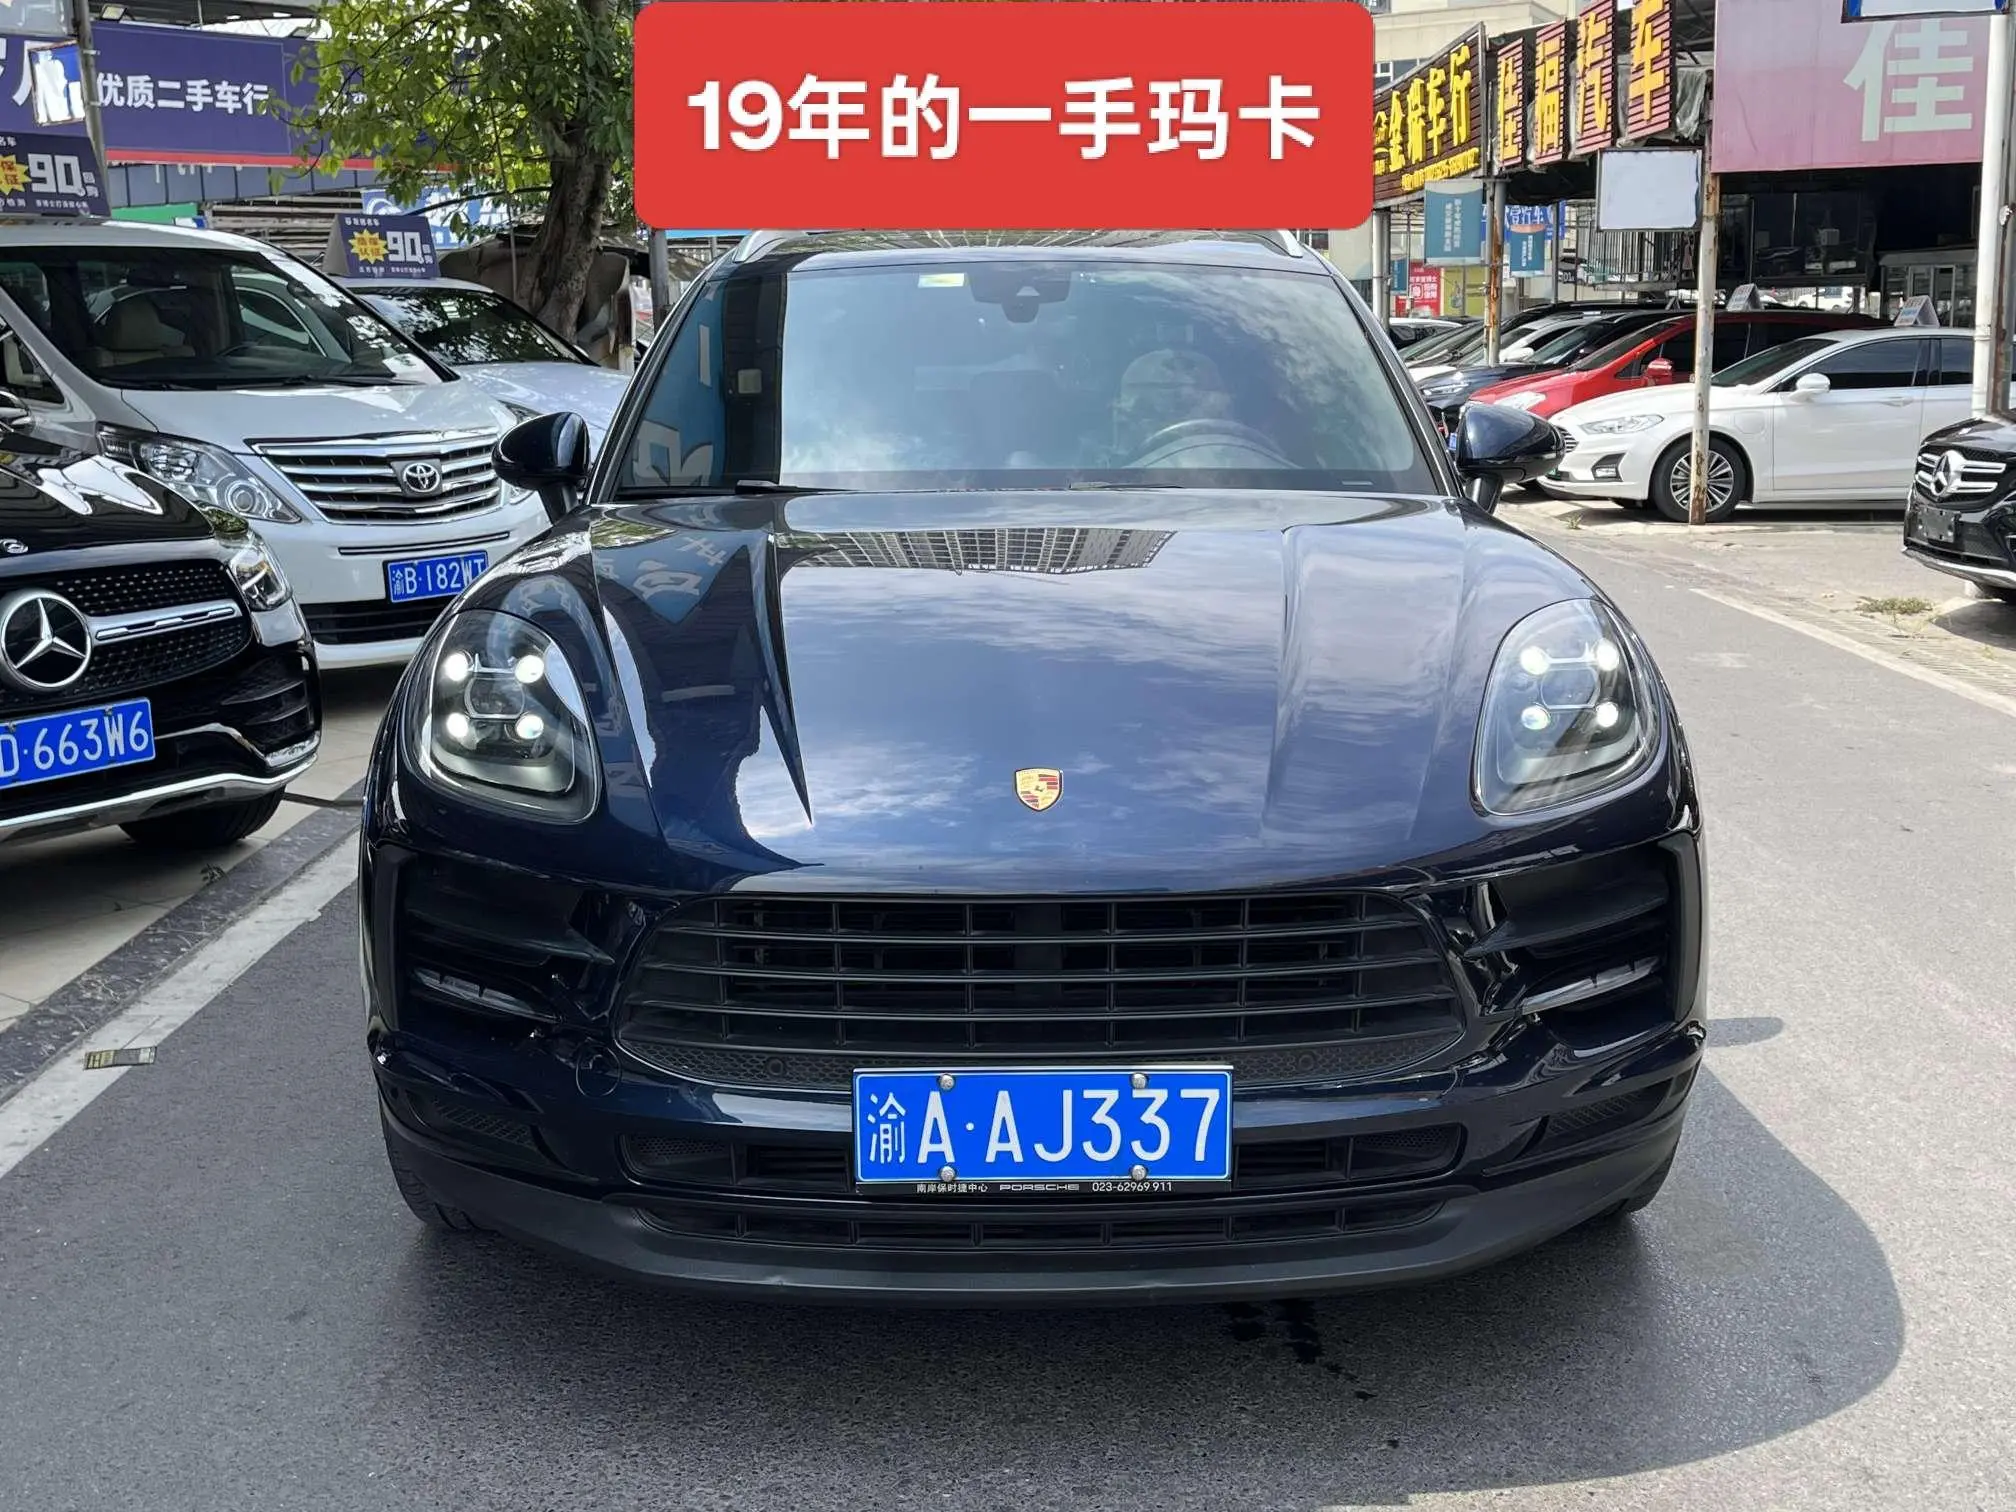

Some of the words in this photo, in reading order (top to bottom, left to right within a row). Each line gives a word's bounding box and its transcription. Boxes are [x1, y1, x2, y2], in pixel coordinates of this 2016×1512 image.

[97, 71, 270, 115] 优质二手车行
[1498, 0, 1667, 161] 佳福汽车
[1843, 19, 1974, 142] 佳
[867, 1089, 1221, 1165] 渝A·AJ337
[916, 1183, 988, 1193] 南岸保时捷中心
